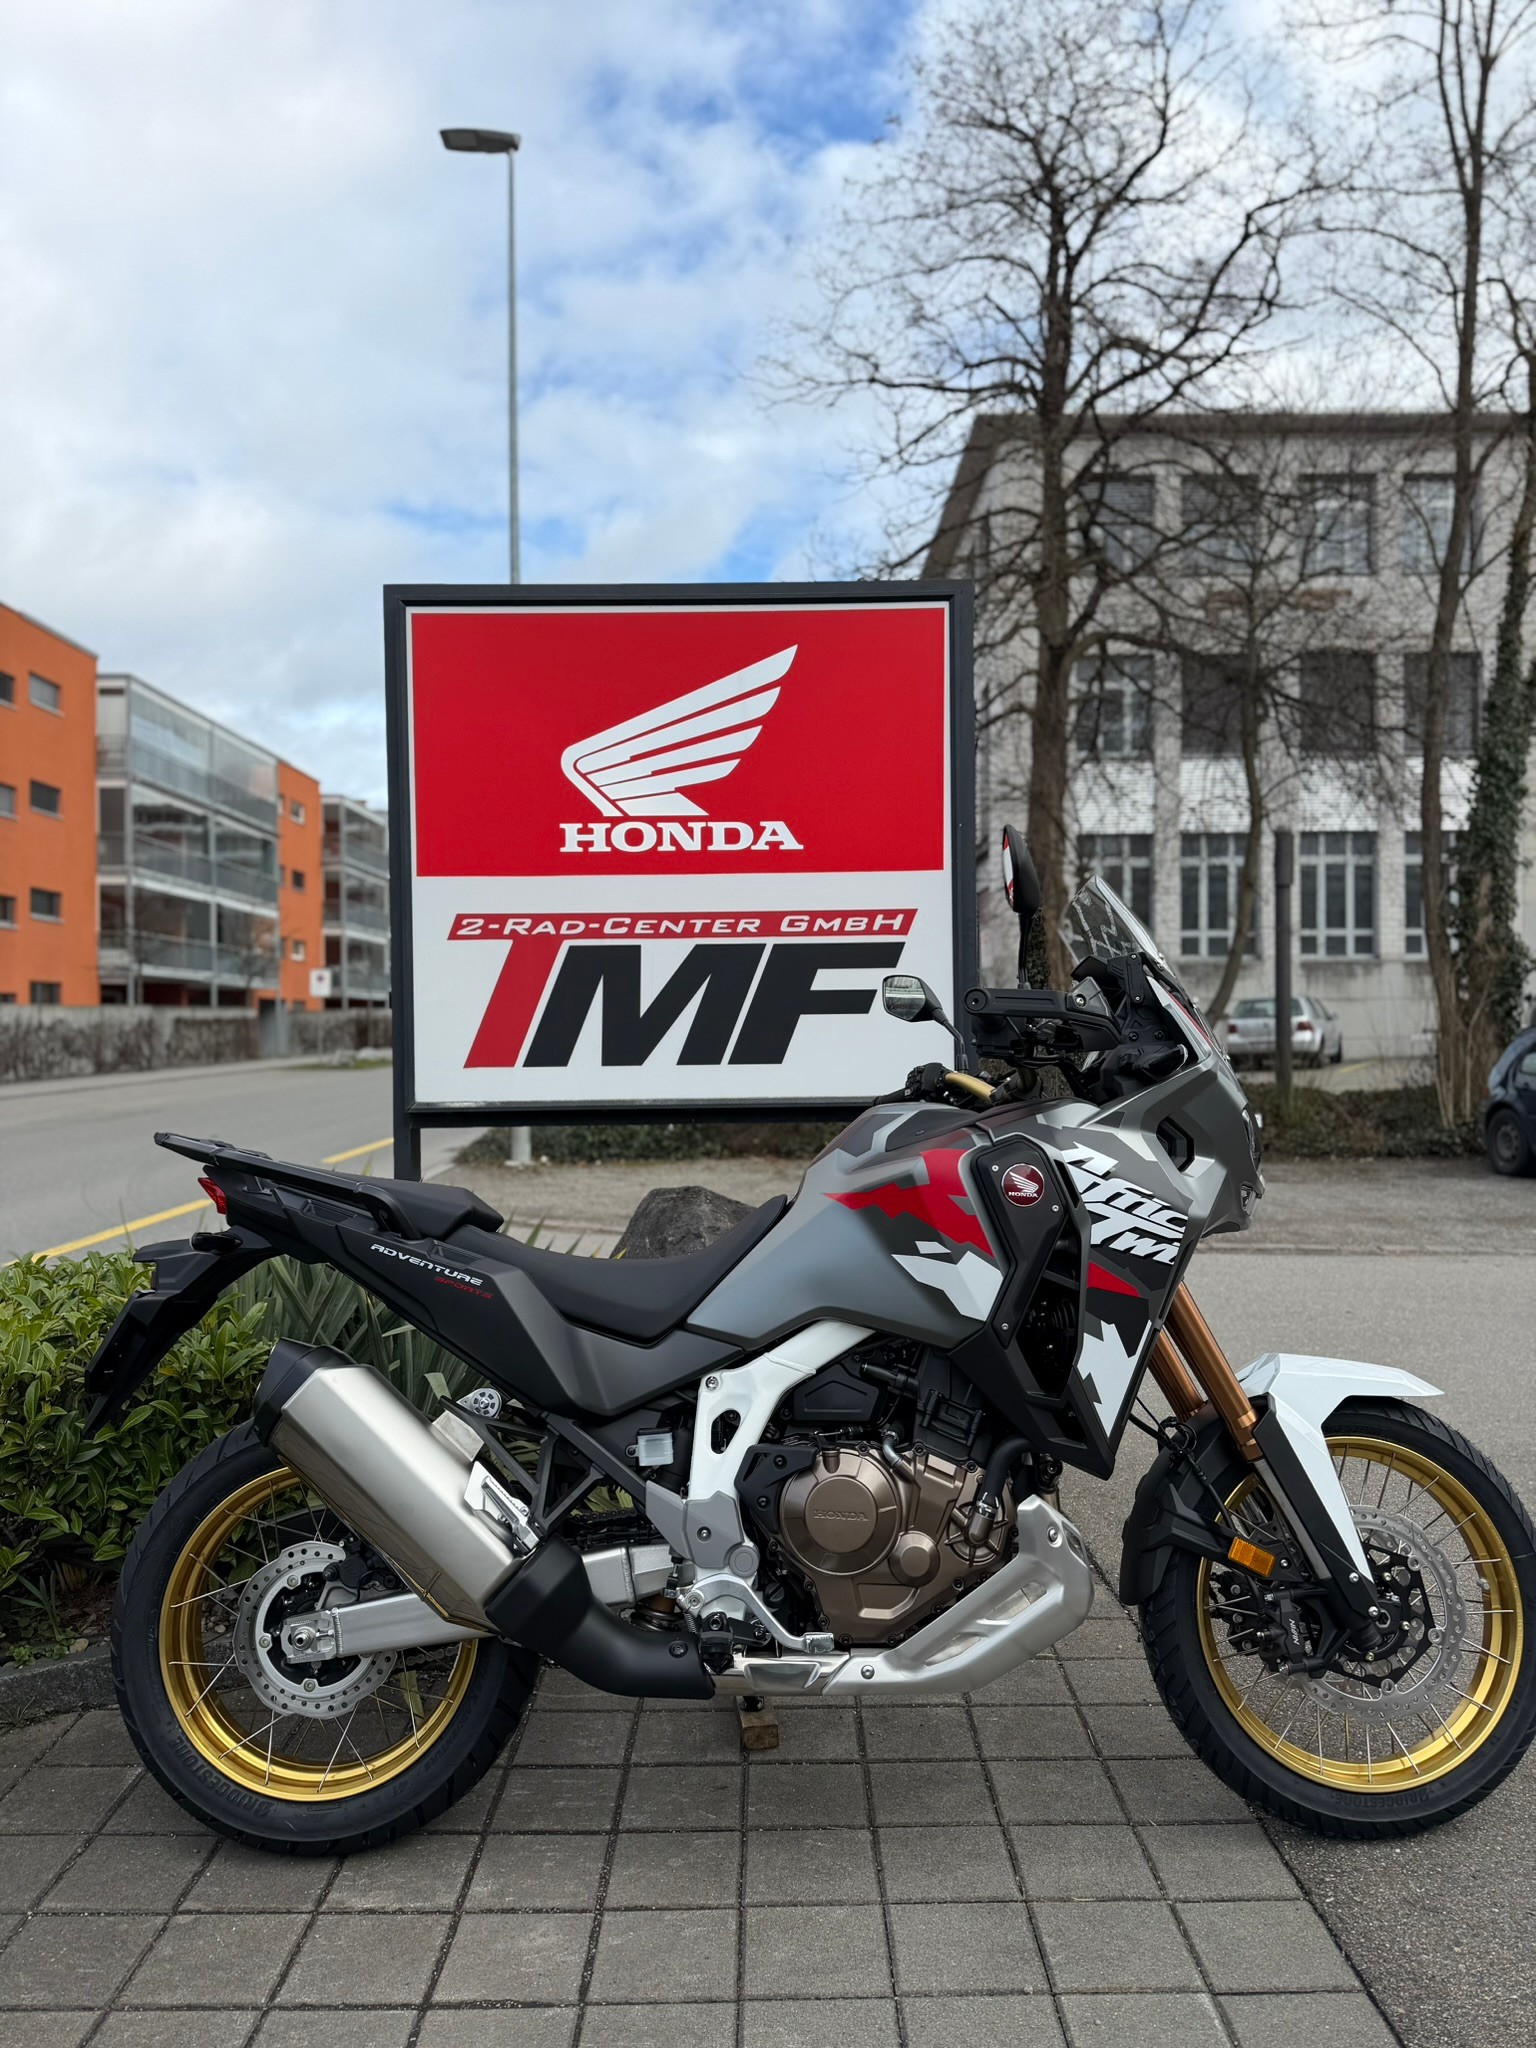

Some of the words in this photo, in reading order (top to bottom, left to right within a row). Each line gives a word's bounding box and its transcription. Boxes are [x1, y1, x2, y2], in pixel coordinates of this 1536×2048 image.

[559, 820, 804, 853] HONDA
[462, 940, 906, 1069] TMF
[370, 1243, 484, 1287] ADVENTURE
[434, 1276, 494, 1299] SPORTS
[813, 1510, 869, 1522] HONDA
[168, 1734, 277, 1819] BRIDGESTONE
[1335, 1787, 1431, 1809] BRIDGESTONE
